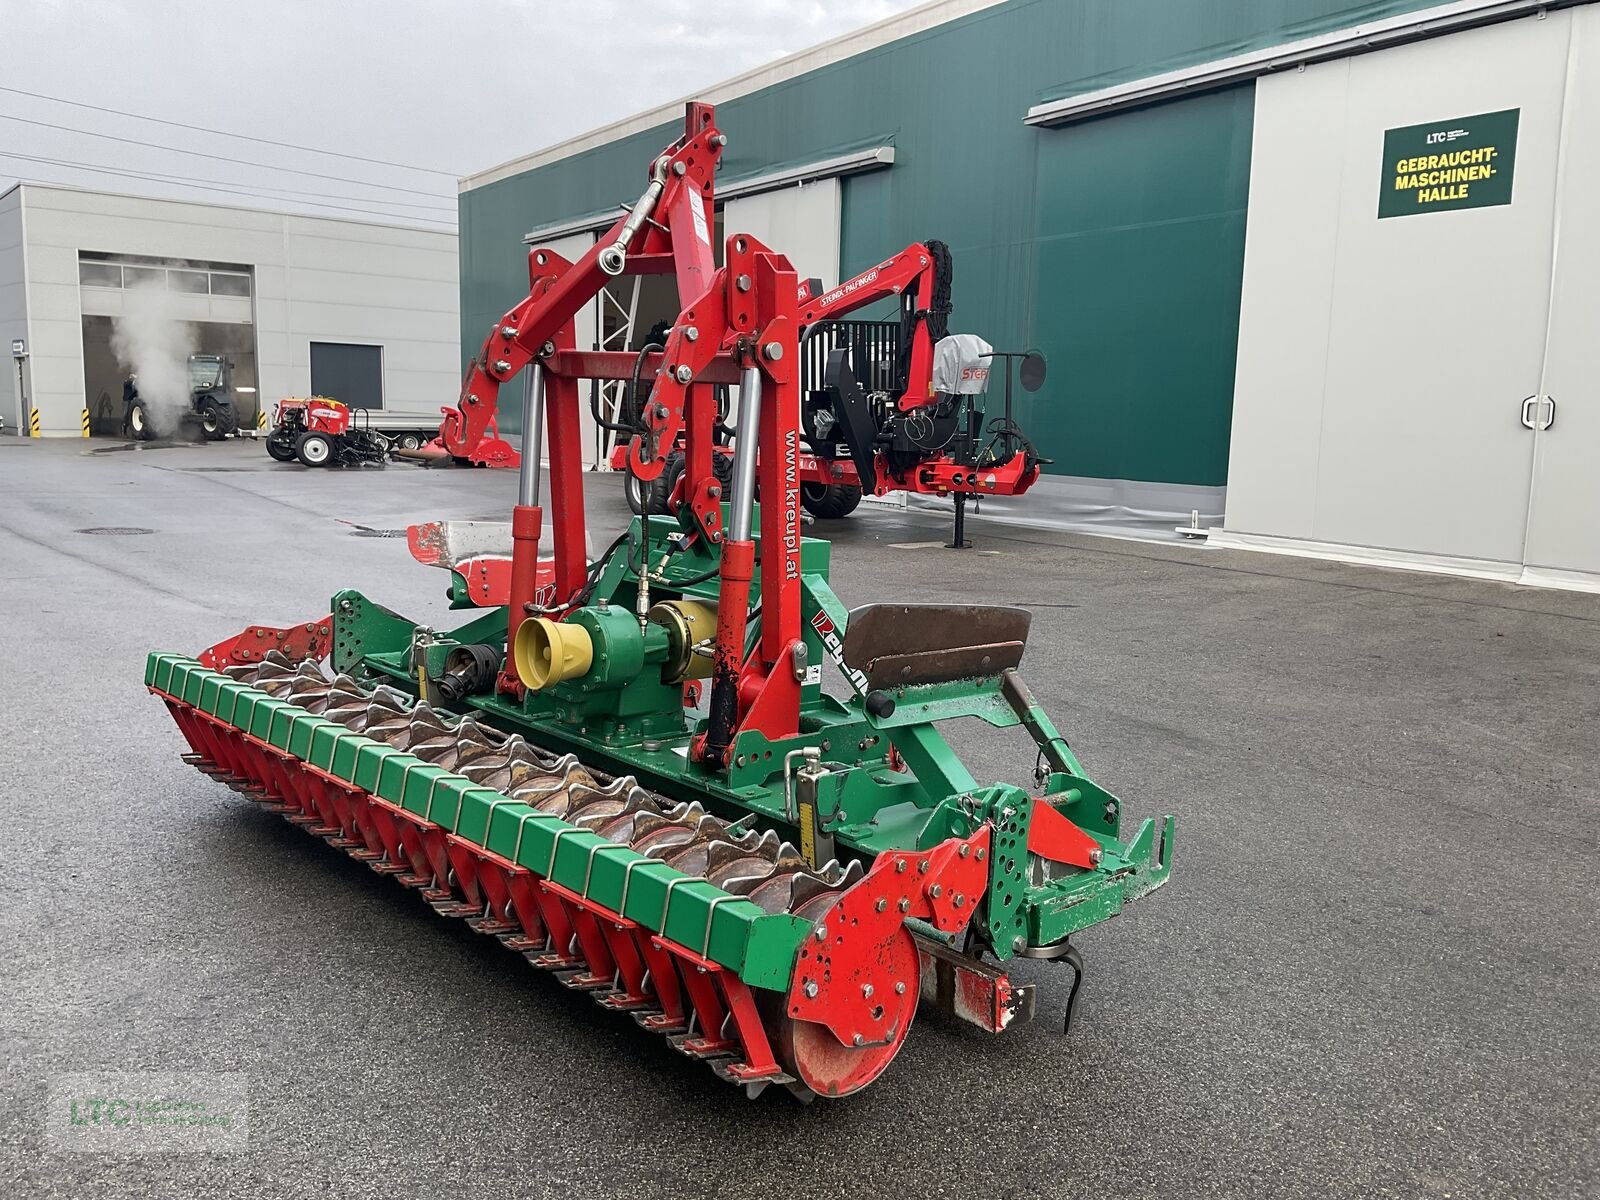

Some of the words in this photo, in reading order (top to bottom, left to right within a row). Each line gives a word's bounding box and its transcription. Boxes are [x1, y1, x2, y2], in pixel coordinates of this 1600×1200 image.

[1427, 132, 1446, 144] LTC
[1397, 147, 1498, 173] GEBRAUCHT-
[1395, 165, 1497, 190] MASCHINEN-
[1418, 184, 1469, 203] HALLE
[962, 368, 988, 380] STEP
[784, 430, 799, 580] www.kreupl.at
